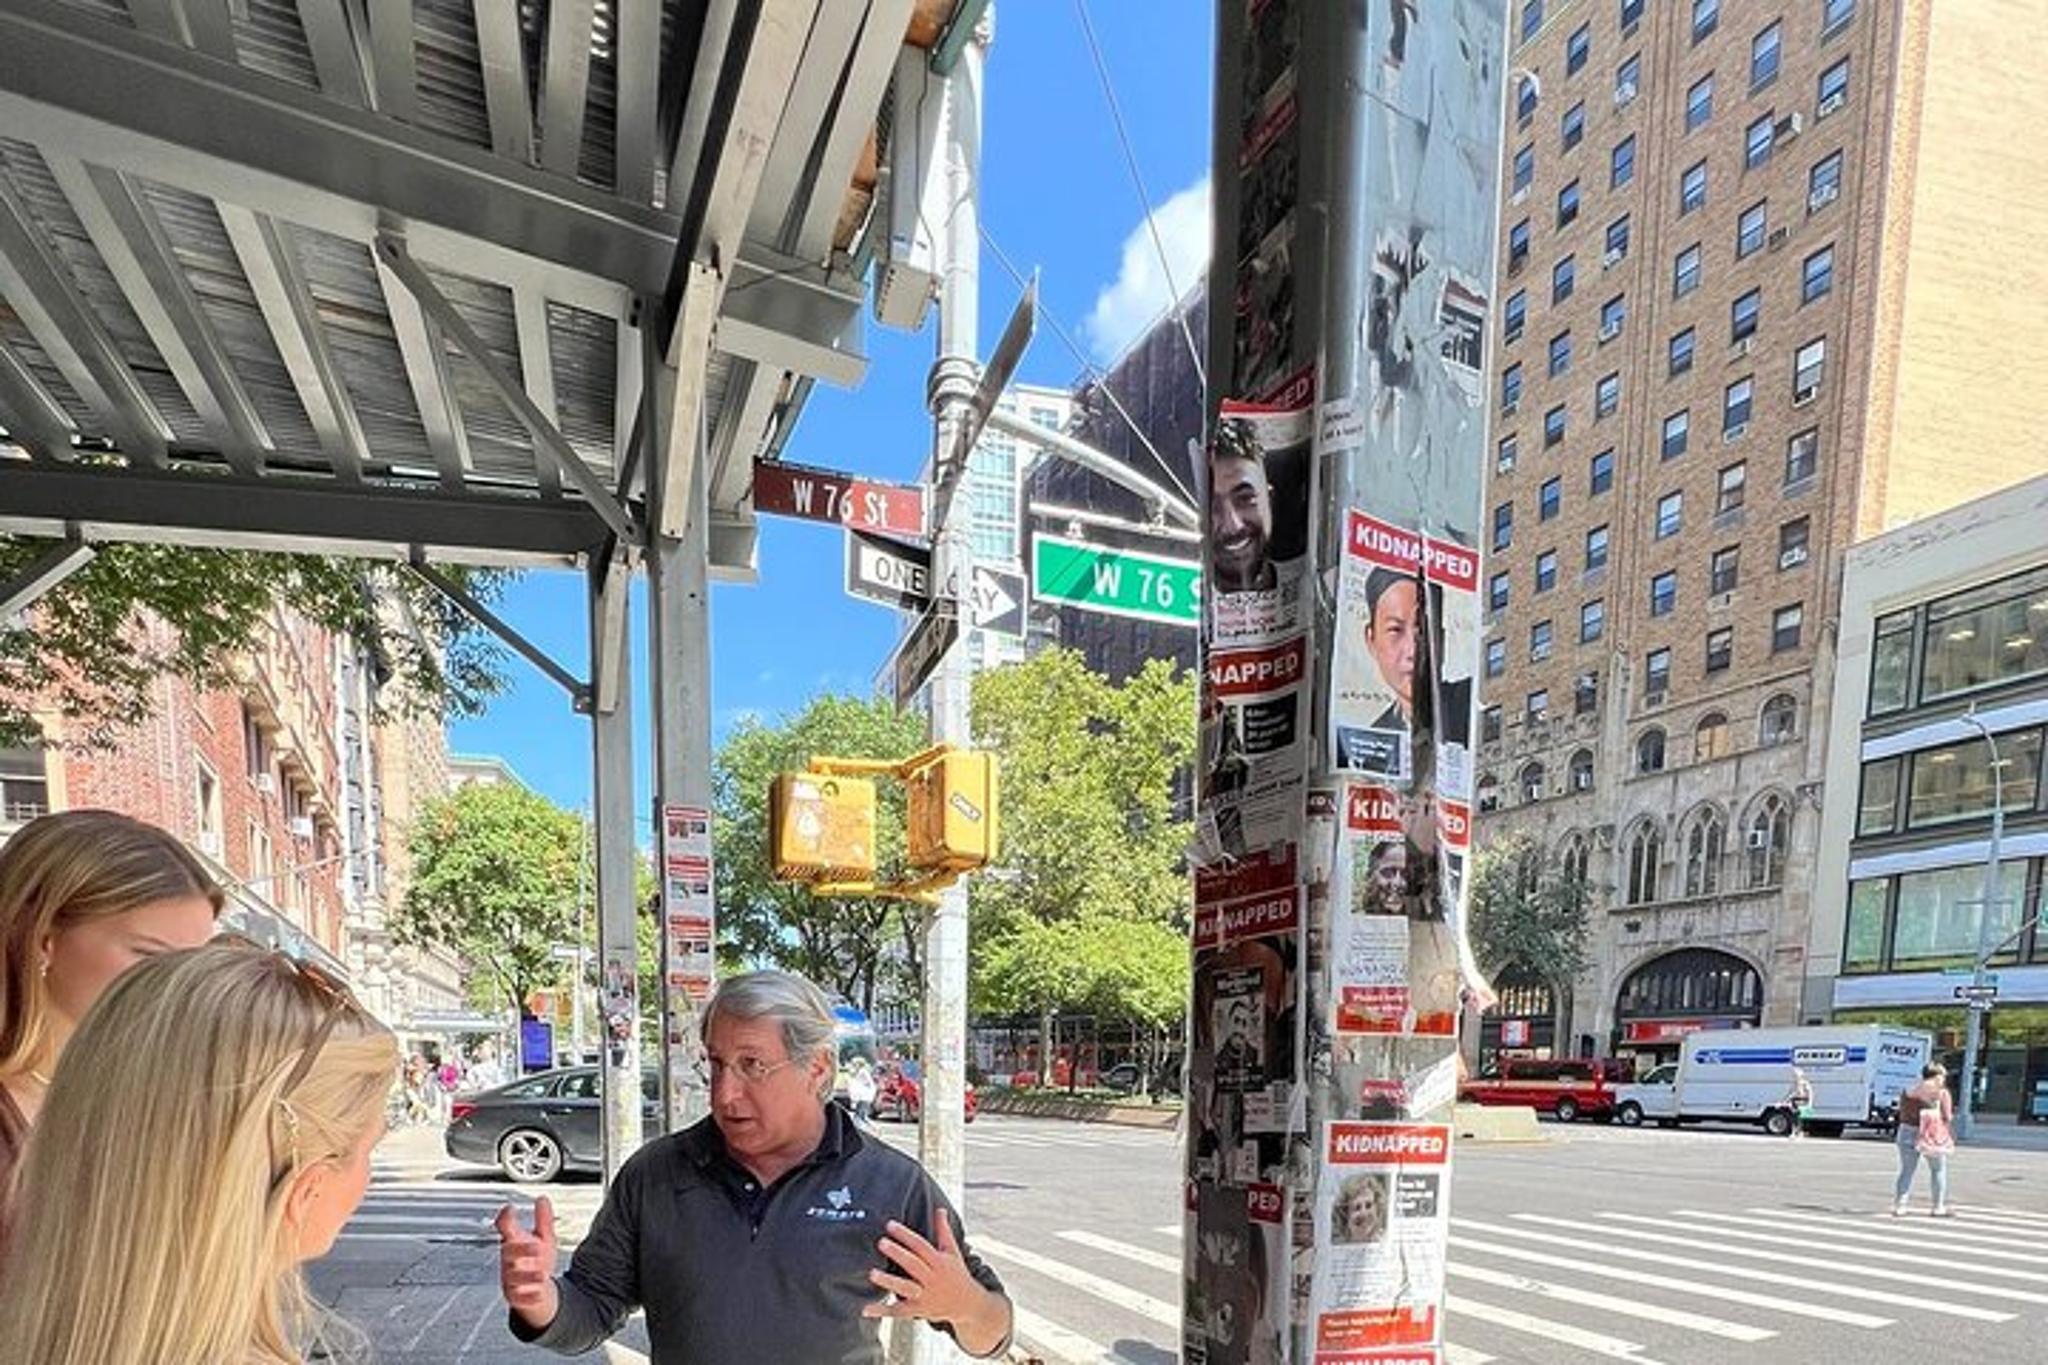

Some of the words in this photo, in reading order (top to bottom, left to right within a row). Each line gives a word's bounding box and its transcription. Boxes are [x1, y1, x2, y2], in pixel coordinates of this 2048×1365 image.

[793, 478, 814, 513] W
[823, 486, 854, 520] 76
[864, 491, 889, 528] St
[1355, 522, 1472, 578] KIDNAPPED
[875, 556, 926, 593] ONE
[1094, 562, 1122, 598] W
[1138, 568, 1174, 608] 76
[1189, 576, 1201, 613] S
[1210, 652, 1298, 685] NAPPED
[1198, 898, 1293, 936] KINAPPED
[1336, 1133, 1444, 1154] KIDNAPPED
